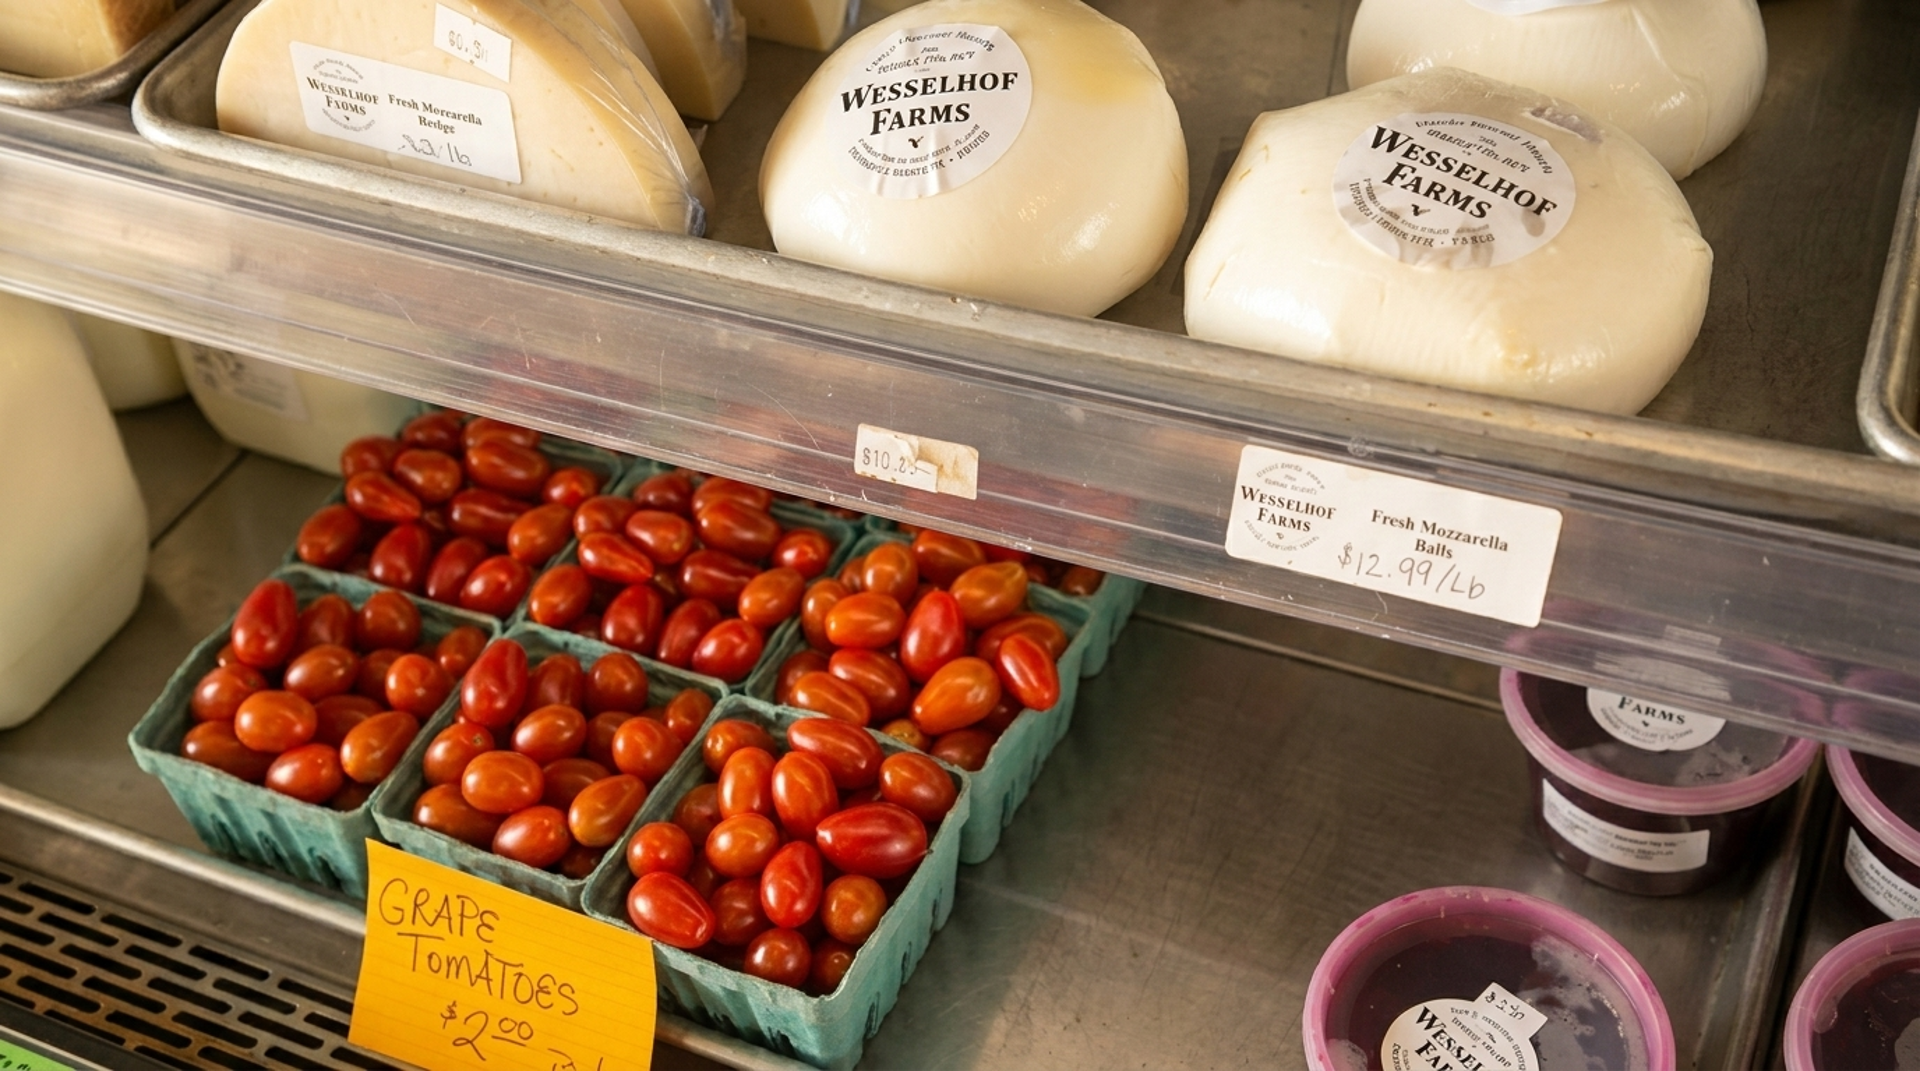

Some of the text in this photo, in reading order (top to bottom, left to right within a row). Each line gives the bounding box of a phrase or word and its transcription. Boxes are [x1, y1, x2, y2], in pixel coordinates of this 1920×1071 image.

[388, 93, 419, 111] Fresh
[841, 71, 1018, 113] WESSELHOF
[870, 102, 971, 136] FARMS
[1370, 125, 1558, 217] WESSELHOF
[1382, 161, 1493, 219] FARMS
[1241, 484, 1337, 519] WESSELHOF
[1257, 507, 1312, 533] FARMS
[1371, 508, 1509, 552] Fresh Mozzarella
[1414, 538, 1454, 559] Balls
[1618, 696, 1686, 725] FARMS
[379, 877, 500, 944] GRAPE
